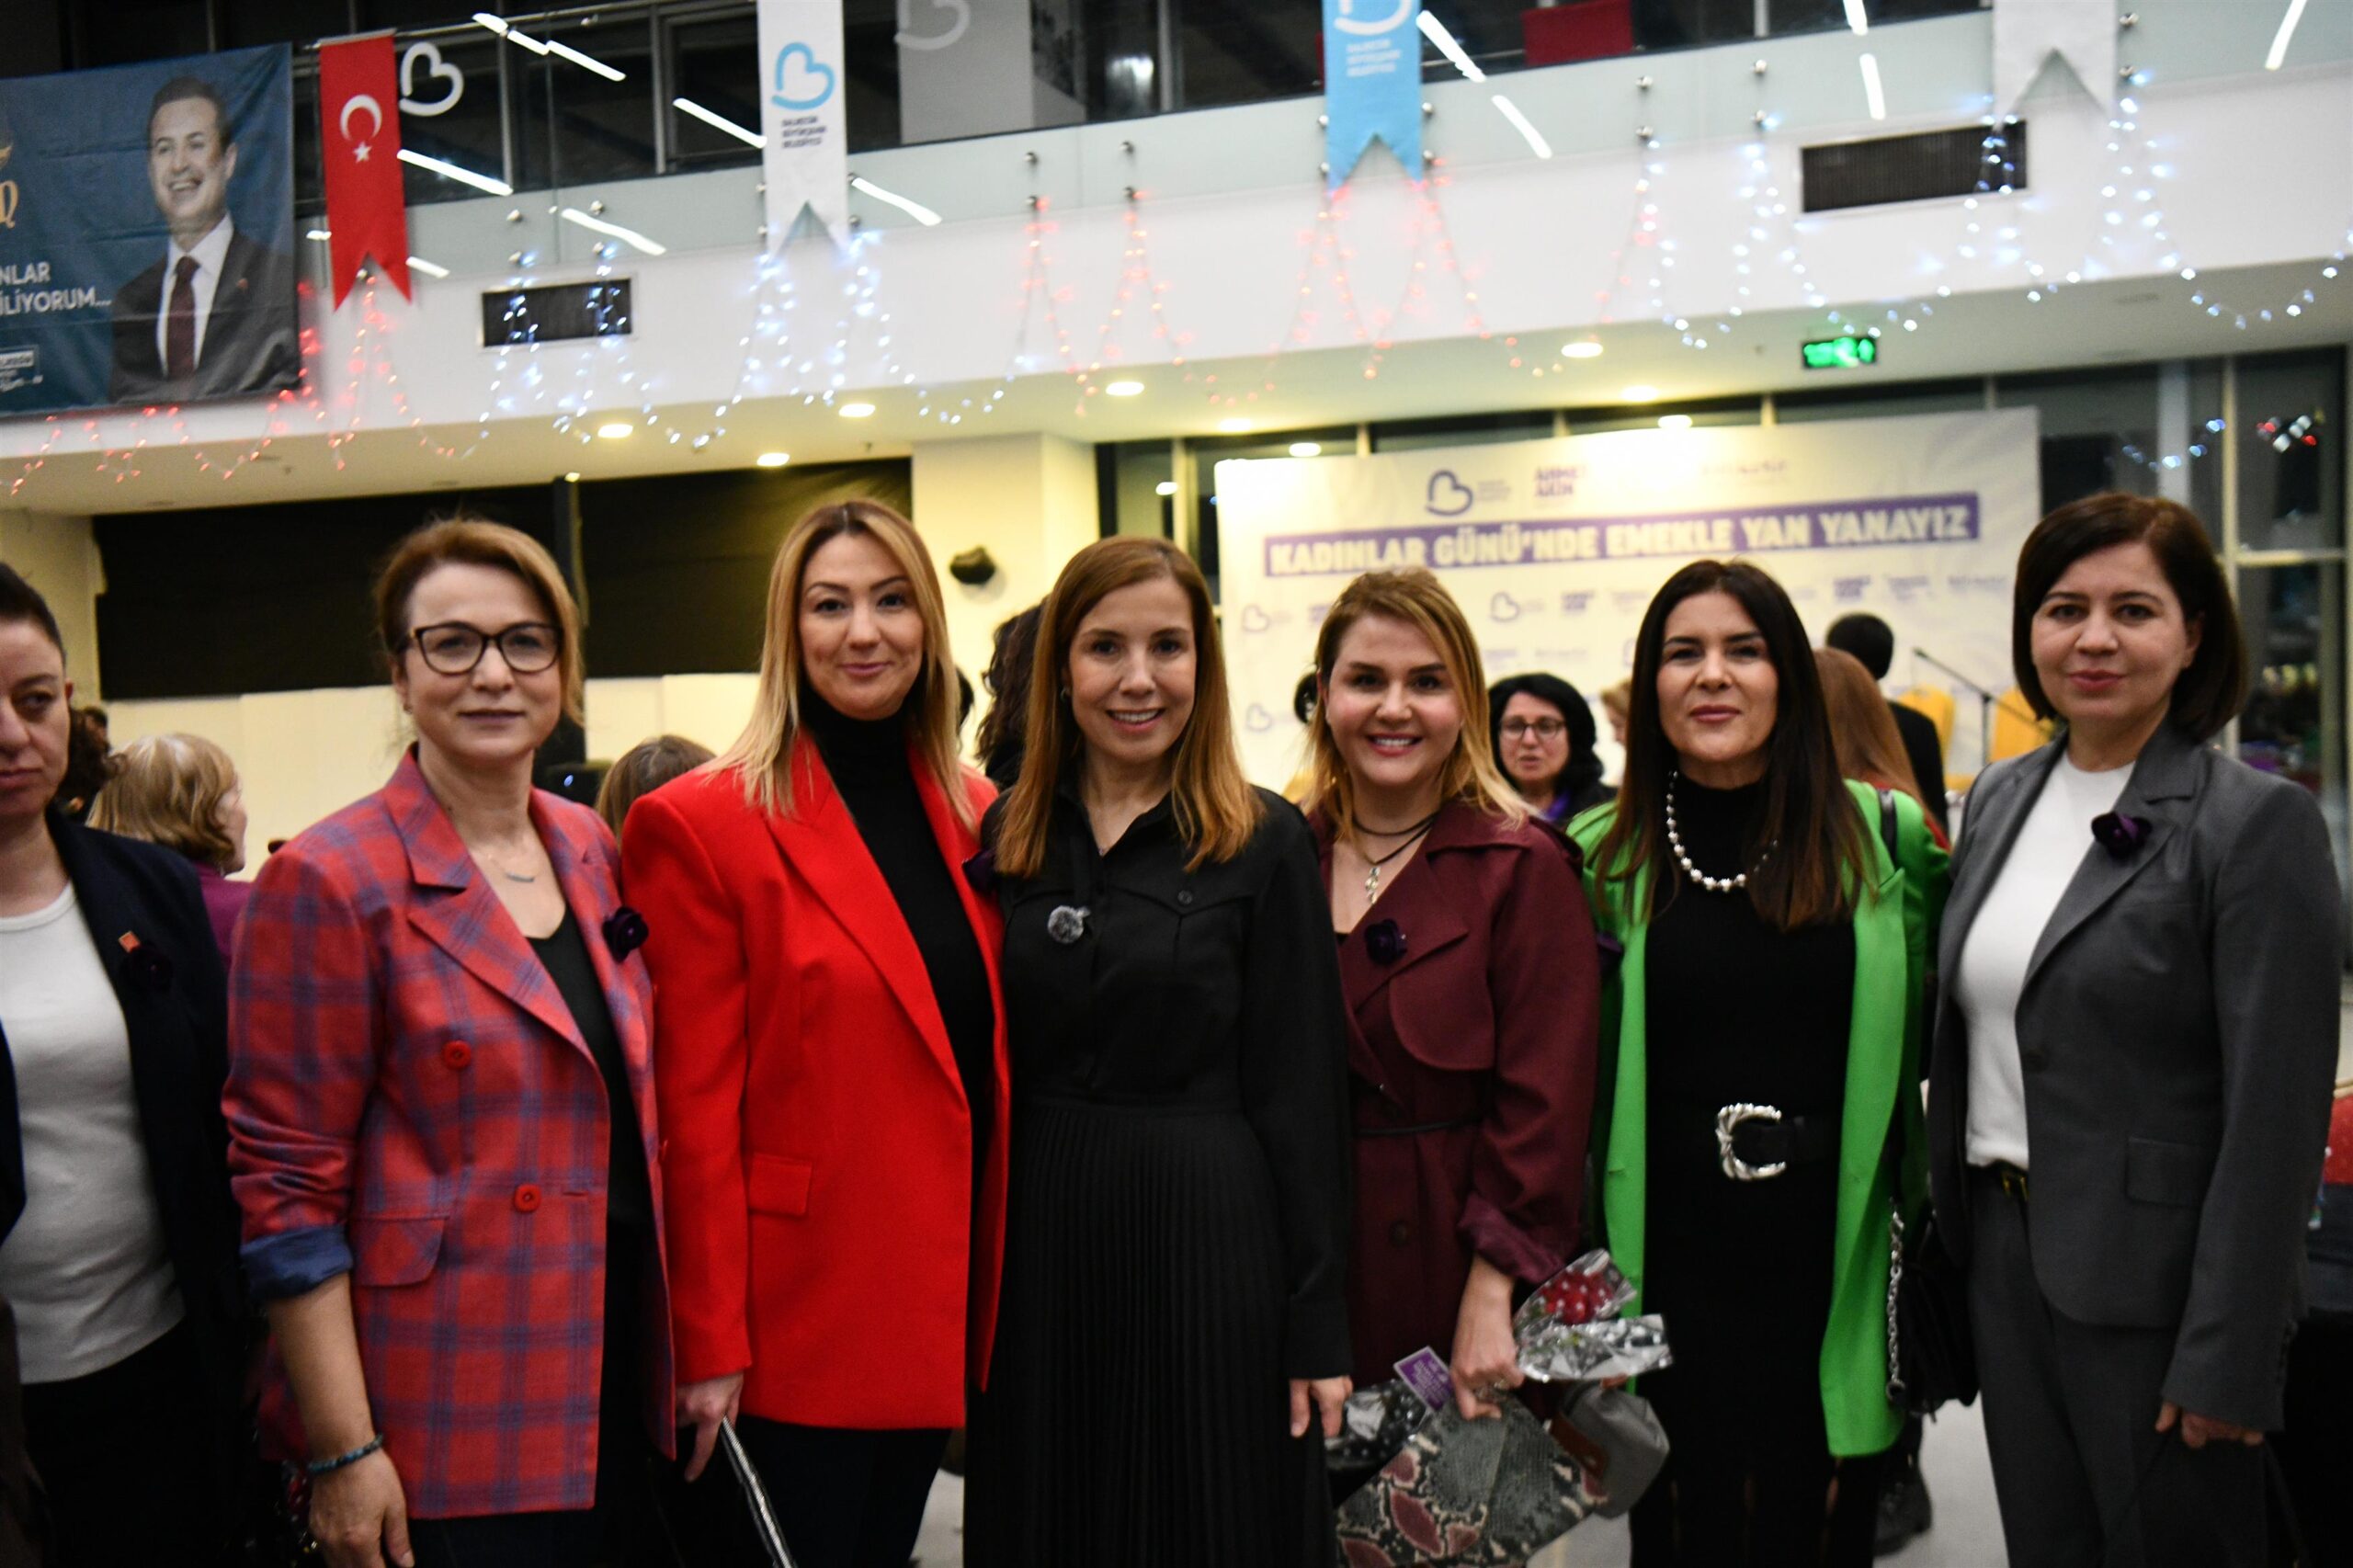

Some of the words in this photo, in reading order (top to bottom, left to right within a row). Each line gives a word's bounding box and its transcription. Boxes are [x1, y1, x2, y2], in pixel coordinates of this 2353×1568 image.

[1269, 536, 1426, 575] KADINLAR
[1605, 517, 1733, 557] EMEKLE
[1742, 512, 1812, 549] YAN
[1819, 505, 1970, 543] YANAYIZ
